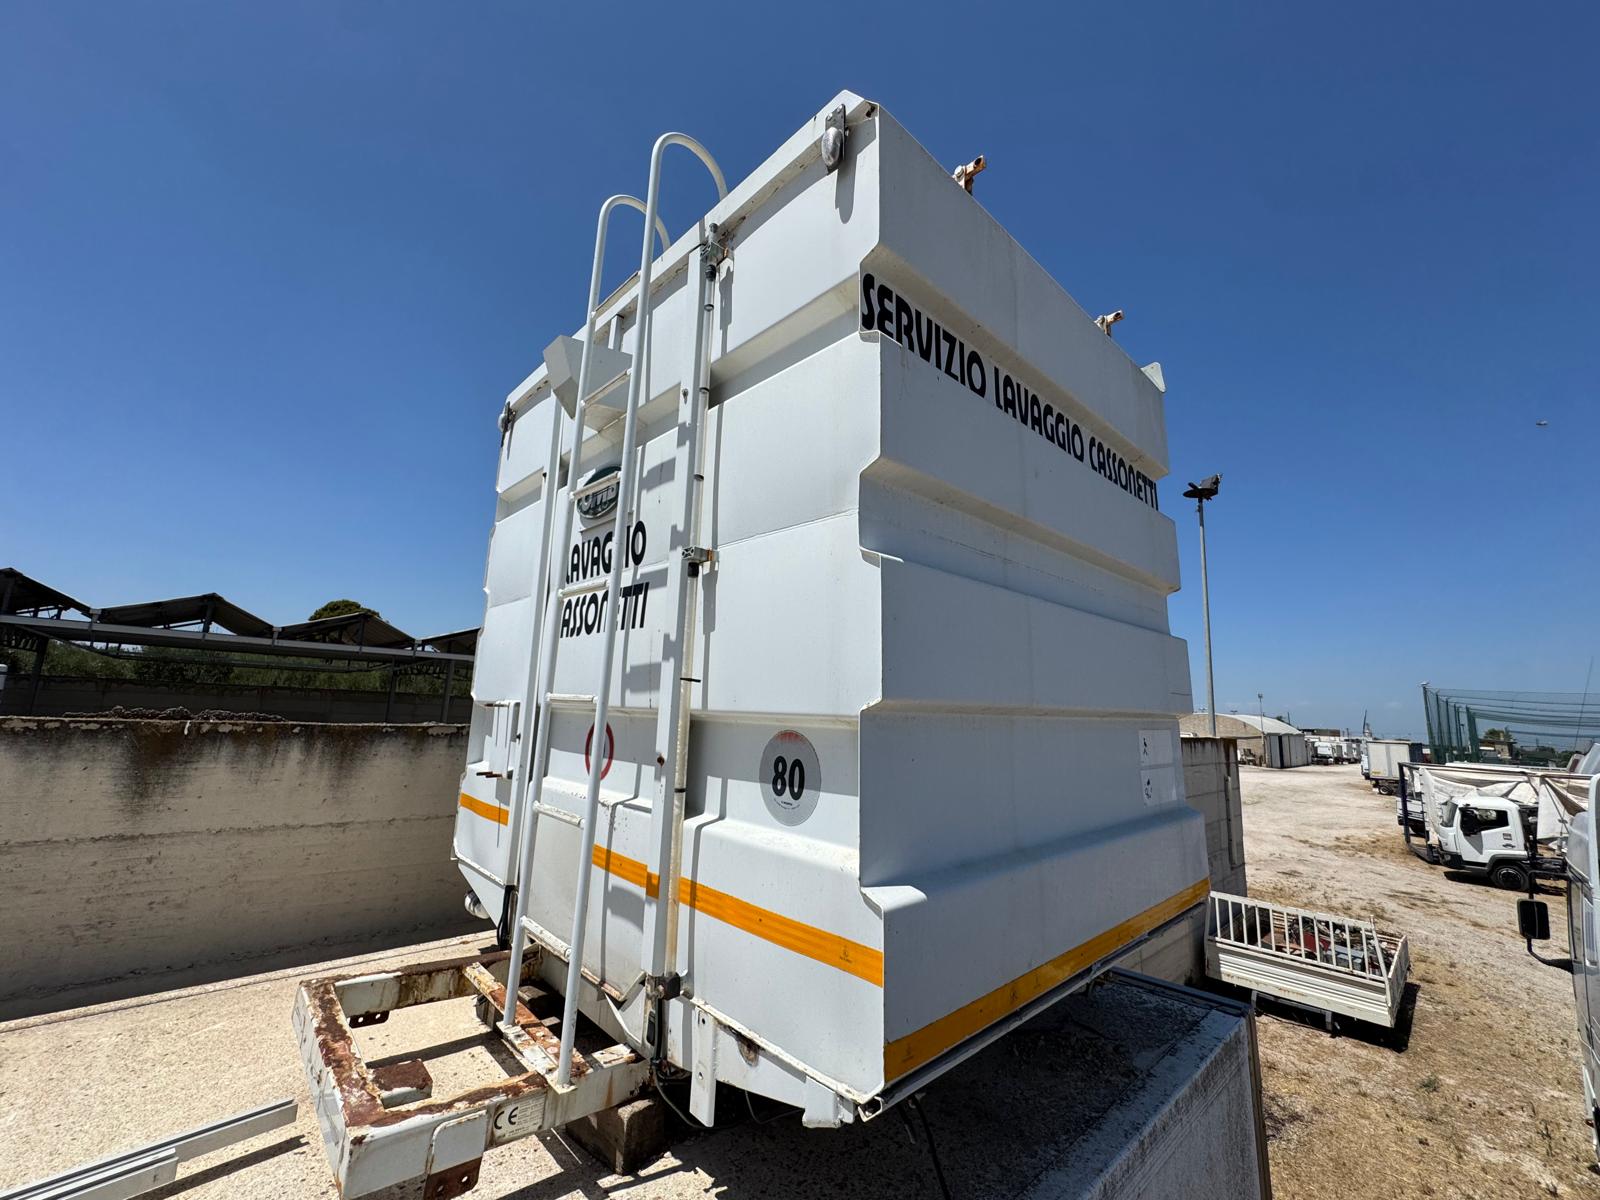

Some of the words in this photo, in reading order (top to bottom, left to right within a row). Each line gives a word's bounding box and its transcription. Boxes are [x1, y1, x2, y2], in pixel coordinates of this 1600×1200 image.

[861, 273, 987, 399] SERVIZIO
[994, 366, 1084, 463] LAVAGGIO
[1089, 436, 1159, 511] CASSONETTI
[566, 520, 647, 585] AVAGIO
[772, 755, 806, 801] 80
[493, 1105, 519, 1130] CE
